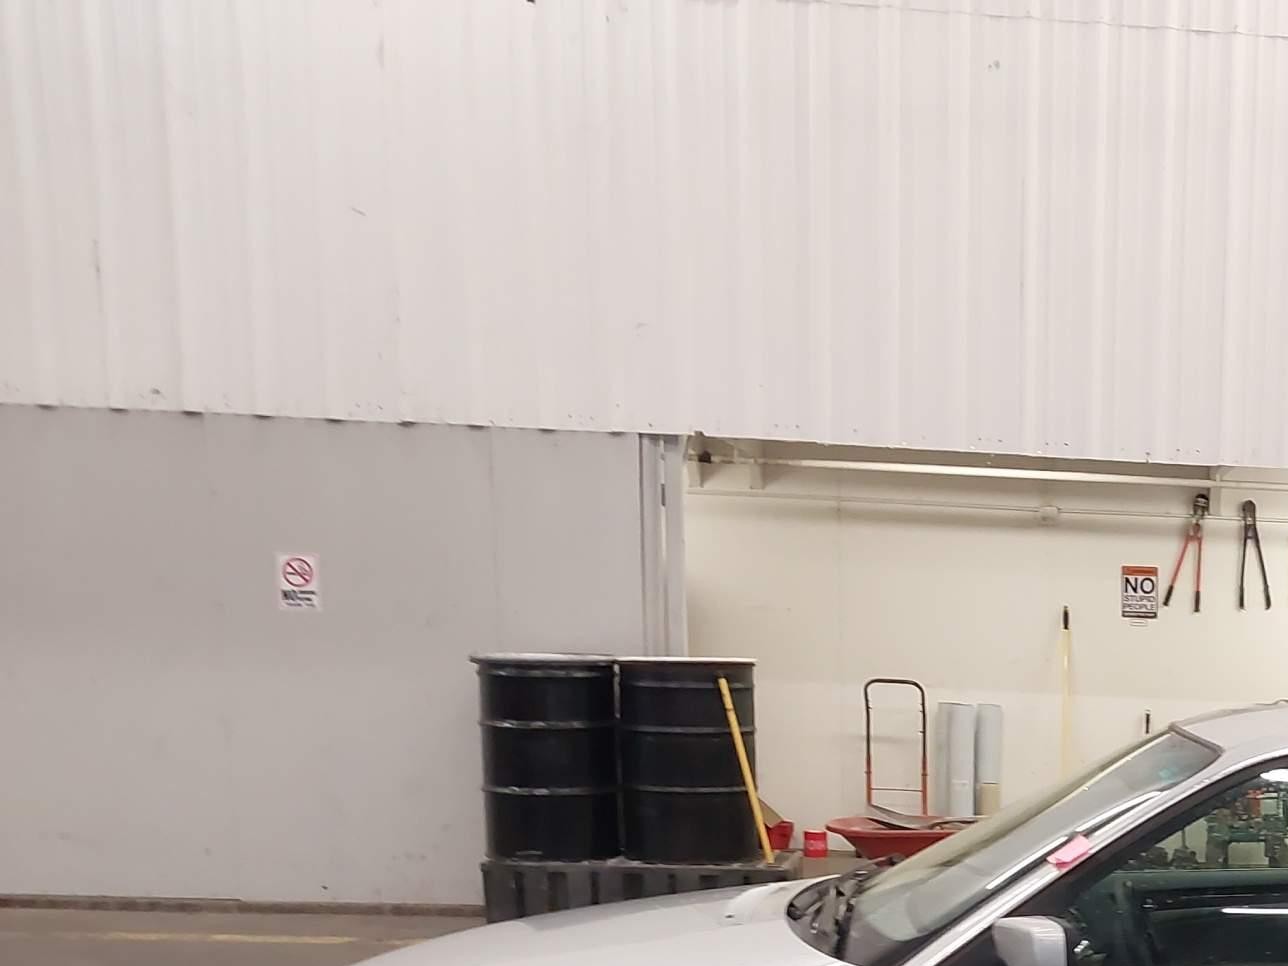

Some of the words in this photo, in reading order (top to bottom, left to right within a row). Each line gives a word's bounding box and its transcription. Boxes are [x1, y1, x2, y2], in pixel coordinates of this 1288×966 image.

[1125, 577, 1155, 594] NO
[1124, 595, 1156, 603] STUPID
[1123, 603, 1155, 611] PEOPLE
